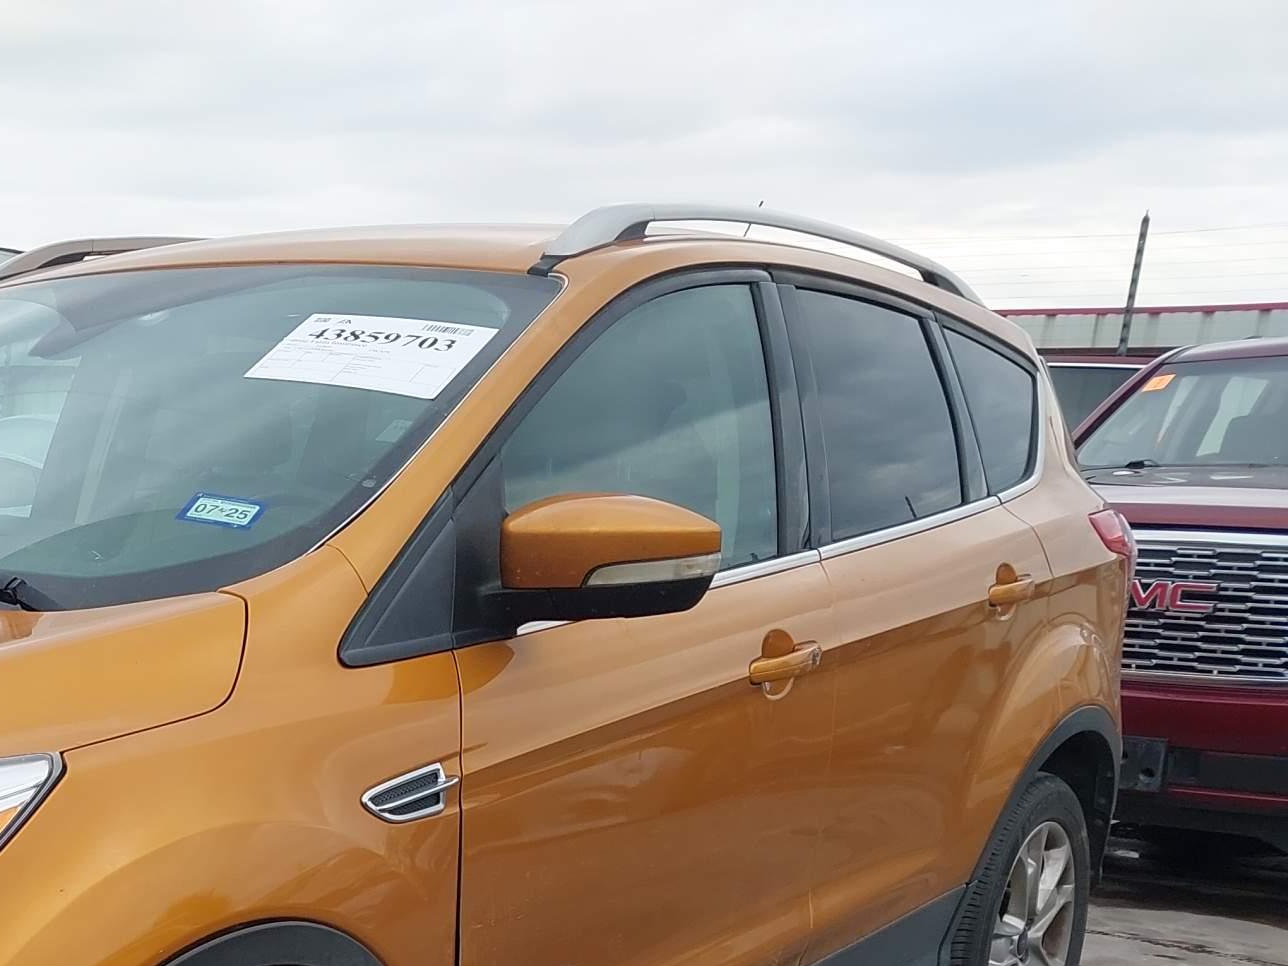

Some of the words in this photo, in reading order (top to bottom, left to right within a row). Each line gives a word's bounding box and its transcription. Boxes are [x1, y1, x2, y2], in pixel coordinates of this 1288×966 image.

[308, 327, 457, 352] 43859703
[194, 503, 219, 515] 07
[223, 507, 252, 520] 25
[1130, 579, 1220, 613] MC
